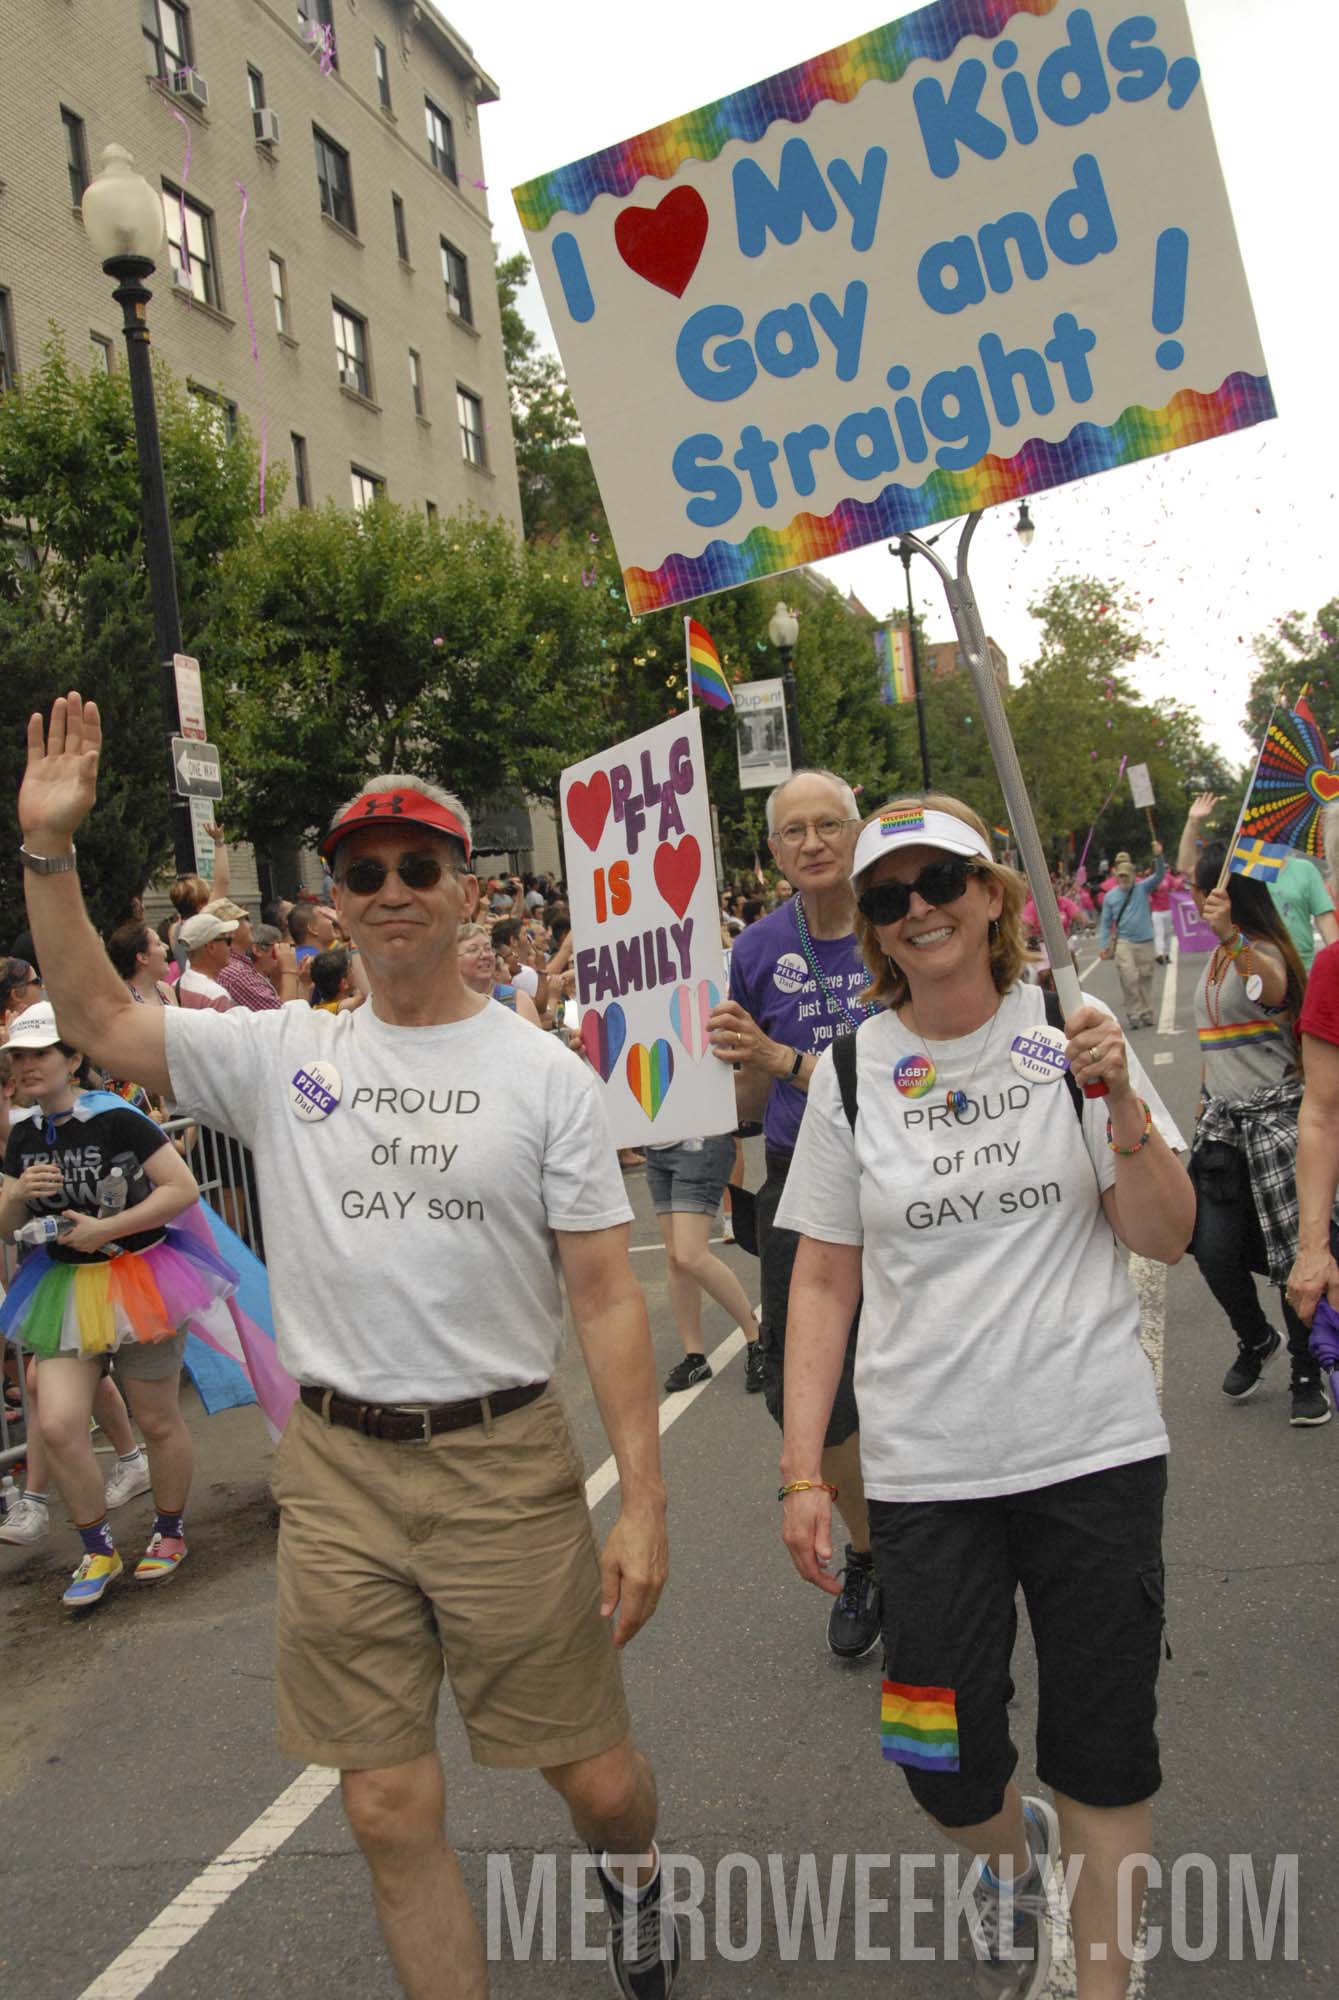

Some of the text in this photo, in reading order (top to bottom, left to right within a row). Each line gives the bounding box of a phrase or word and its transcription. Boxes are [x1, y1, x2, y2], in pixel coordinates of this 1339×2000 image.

[552, 9, 1200, 323] I My Kids,
[676, 153, 1118, 402] Gay and
[671, 312, 1096, 527] Straight
[593, 860, 632, 923] IS
[576, 917, 694, 1005] FAMILY
[776, 966, 803, 981] PFLAG
[799, 999, 821, 1021] just
[812, 1025, 833, 1044] you
[1032, 1031, 1062, 1049] I'm a
[1018, 1040, 1066, 1066] PFLAG
[1019, 1056, 1051, 1076] Mom
[310, 1067, 326, 1085] I'm
[898, 1067, 928, 1077] LGBT
[898, 1079, 928, 1087] OBAMA
[294, 1093, 315, 1114] Dad
[296, 1075, 332, 1109] PFLAG
[351, 1088, 480, 1114] PROUD
[904, 1085, 1030, 1131] PROUD
[371, 1137, 458, 1172] of my
[933, 1140, 1021, 1175] of my
[341, 1190, 484, 1221] GAY son
[905, 1181, 1061, 1230] GAY son
